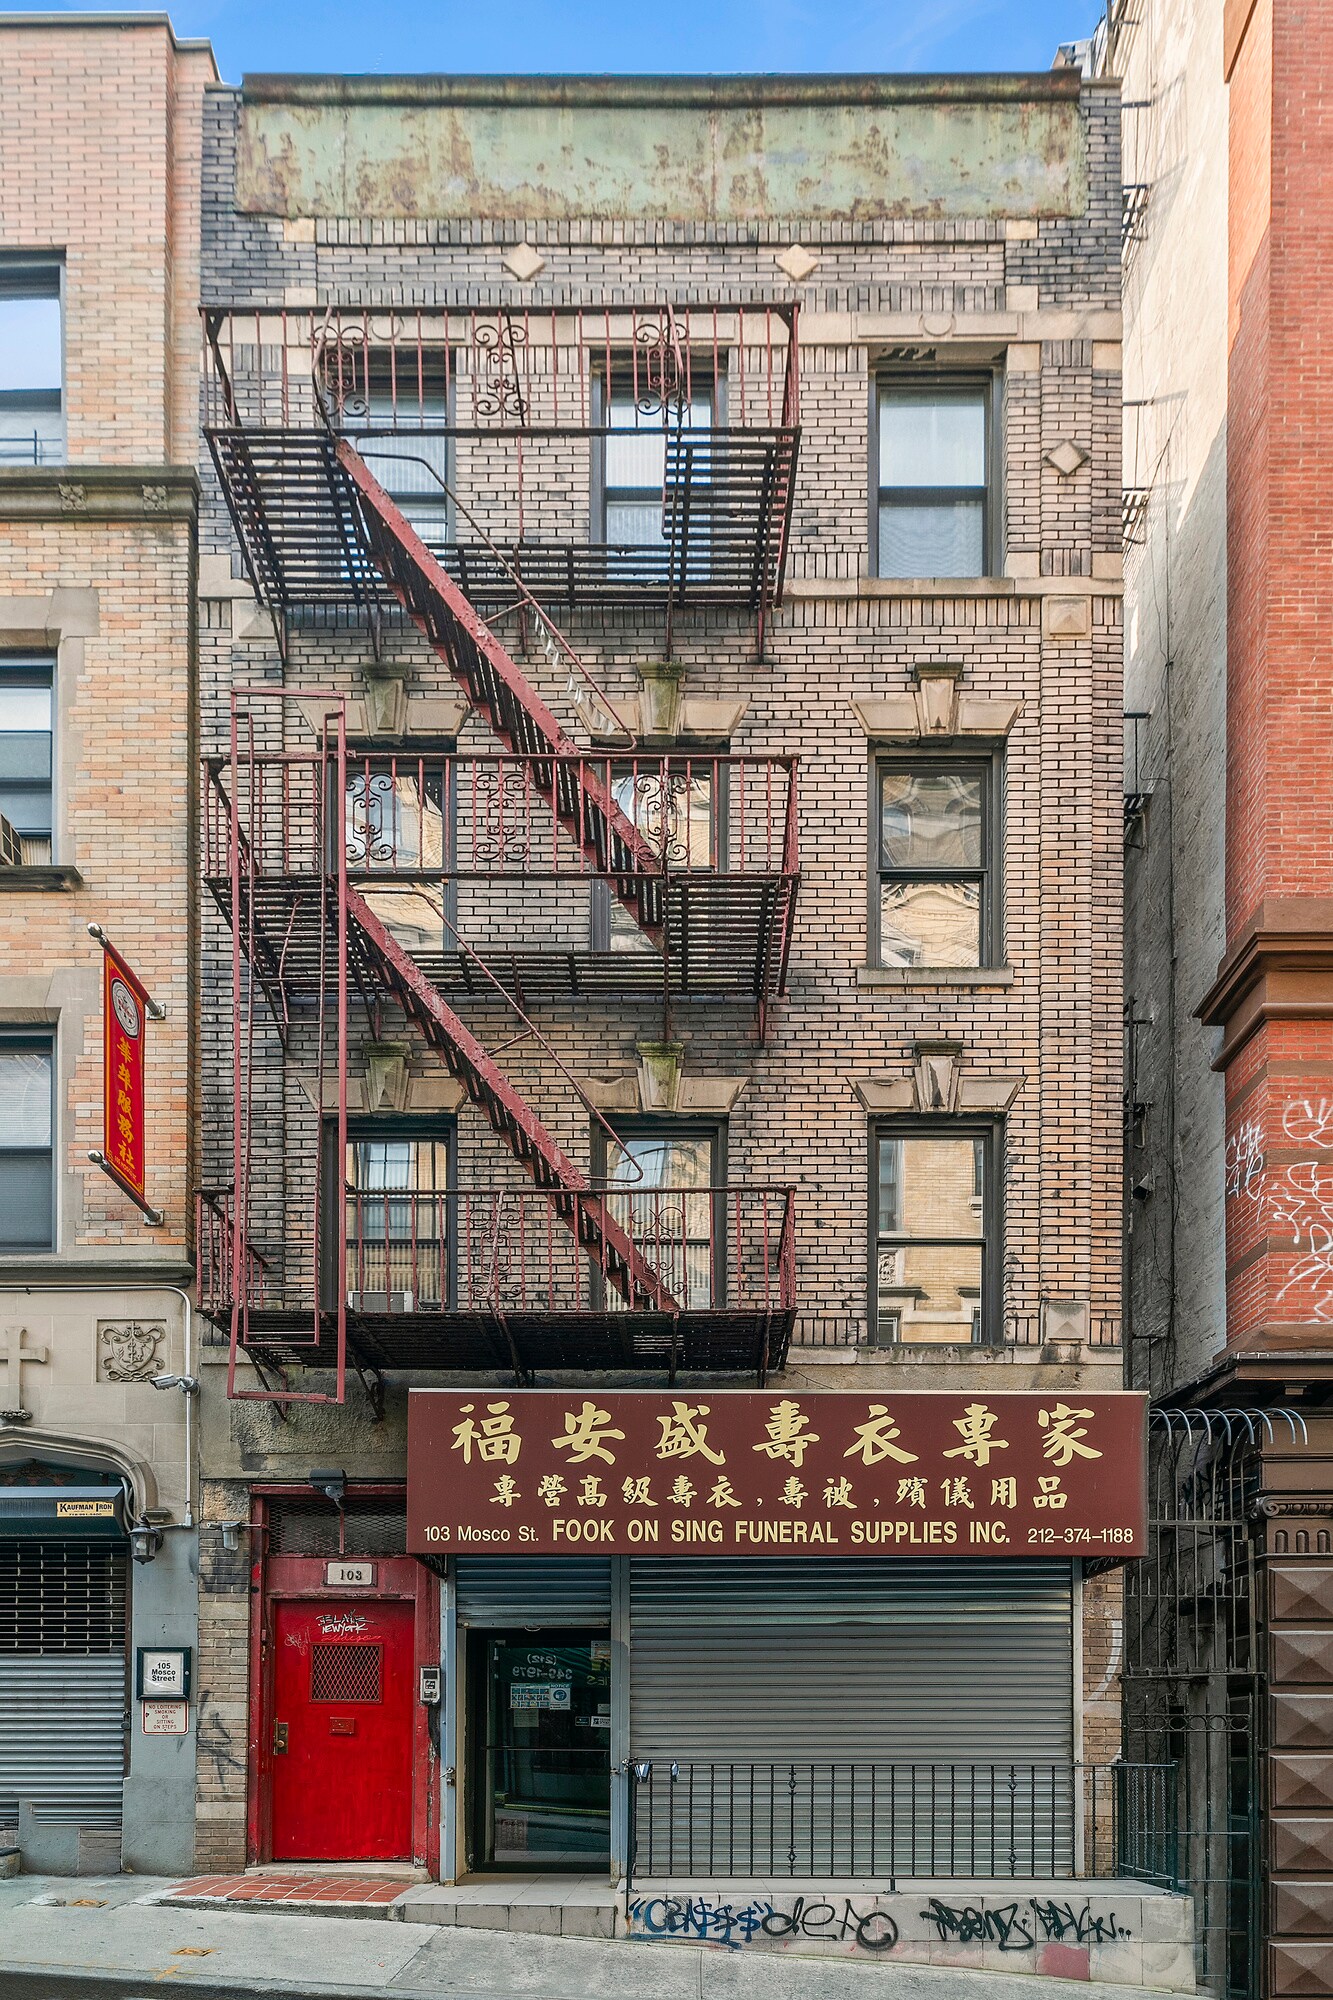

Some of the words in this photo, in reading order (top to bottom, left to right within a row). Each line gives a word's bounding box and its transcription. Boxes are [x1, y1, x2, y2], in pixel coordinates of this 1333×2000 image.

[60, 1503, 93, 1512] KAUFMAN
[96, 1503, 112, 1512] IRON
[424, 1525, 451, 1542] 103
[457, 1525, 511, 1542] Mosco
[518, 1525, 540, 1542] St.
[552, 1519, 615, 1542] FOOK
[627, 1519, 659, 1542] ON
[671, 1519, 723, 1543] SING
[735, 1520, 839, 1543] FUNERAL
[850, 1520, 958, 1544] SUPPLIES
[969, 1520, 1011, 1544] INC.
[1027, 1527, 1134, 1544] 212-374-1188
[340, 1569, 363, 1581] 103
